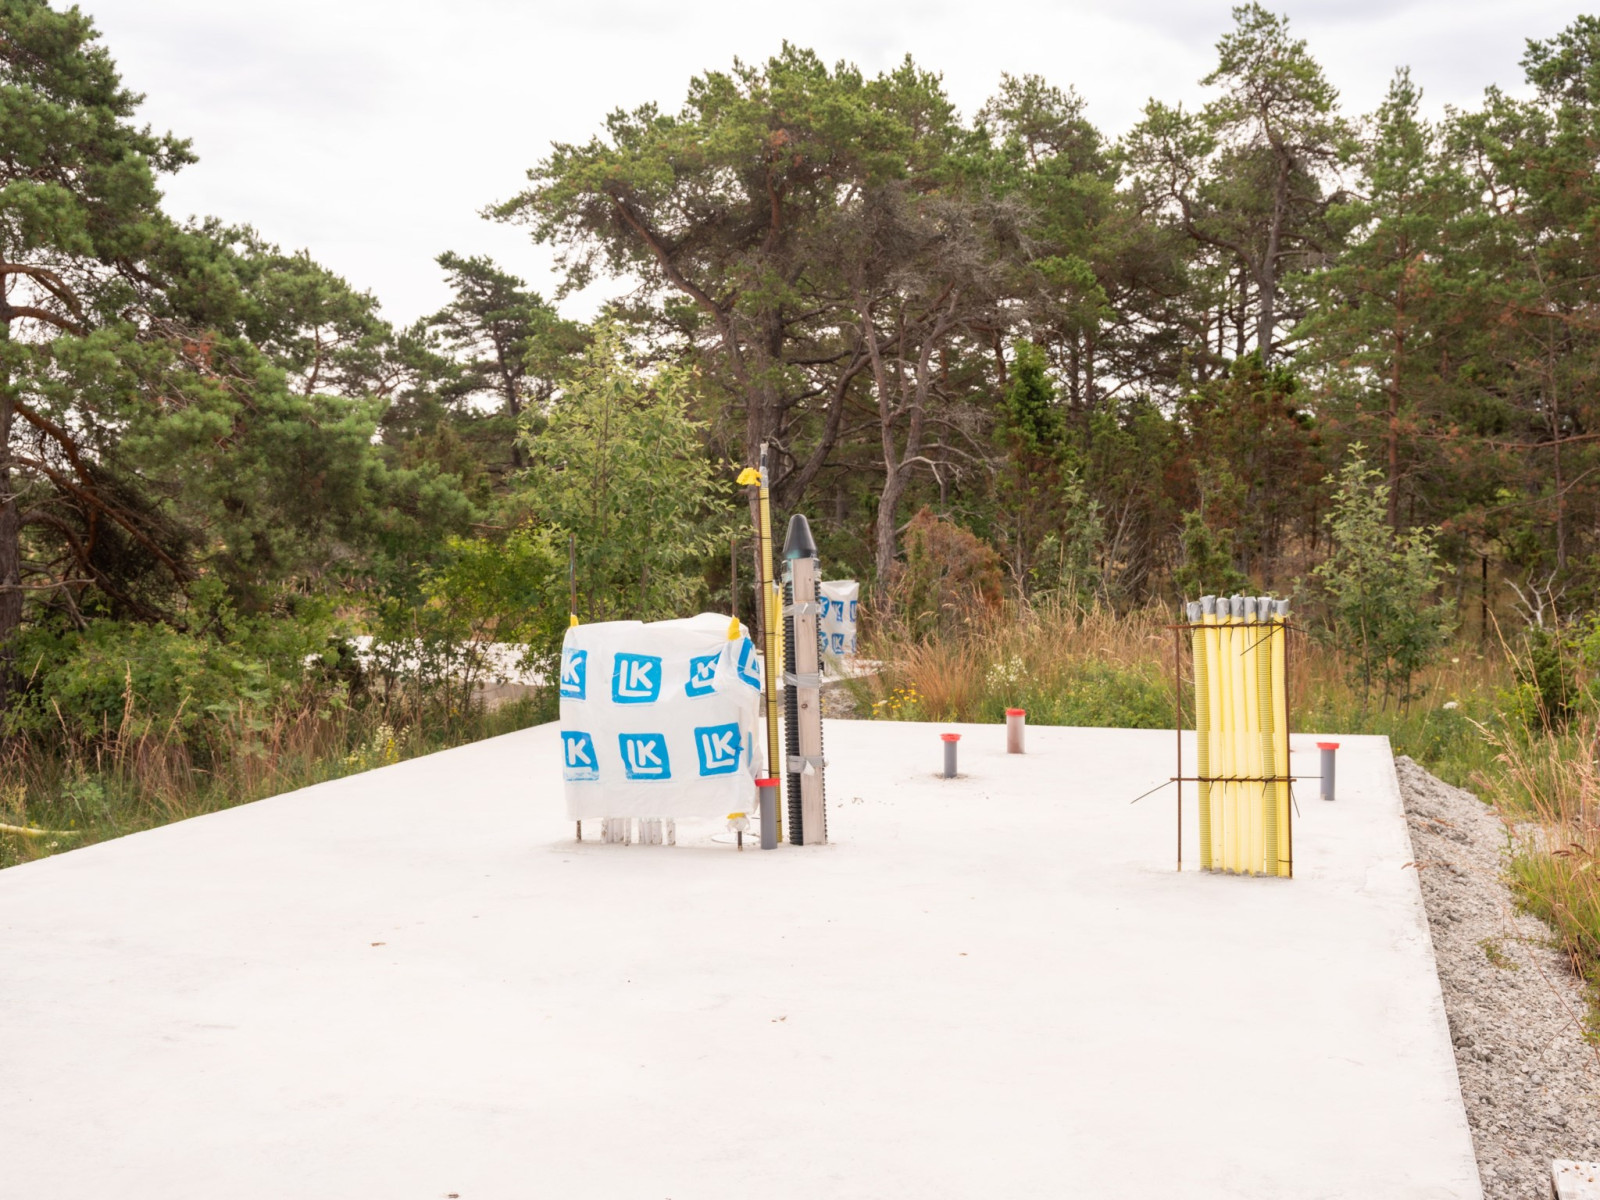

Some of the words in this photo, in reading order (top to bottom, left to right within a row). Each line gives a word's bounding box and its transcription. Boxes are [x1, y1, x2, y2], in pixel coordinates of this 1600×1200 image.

[618, 660, 653, 697] LK
[626, 739, 663, 774] LK
[701, 730, 735, 769] LK
